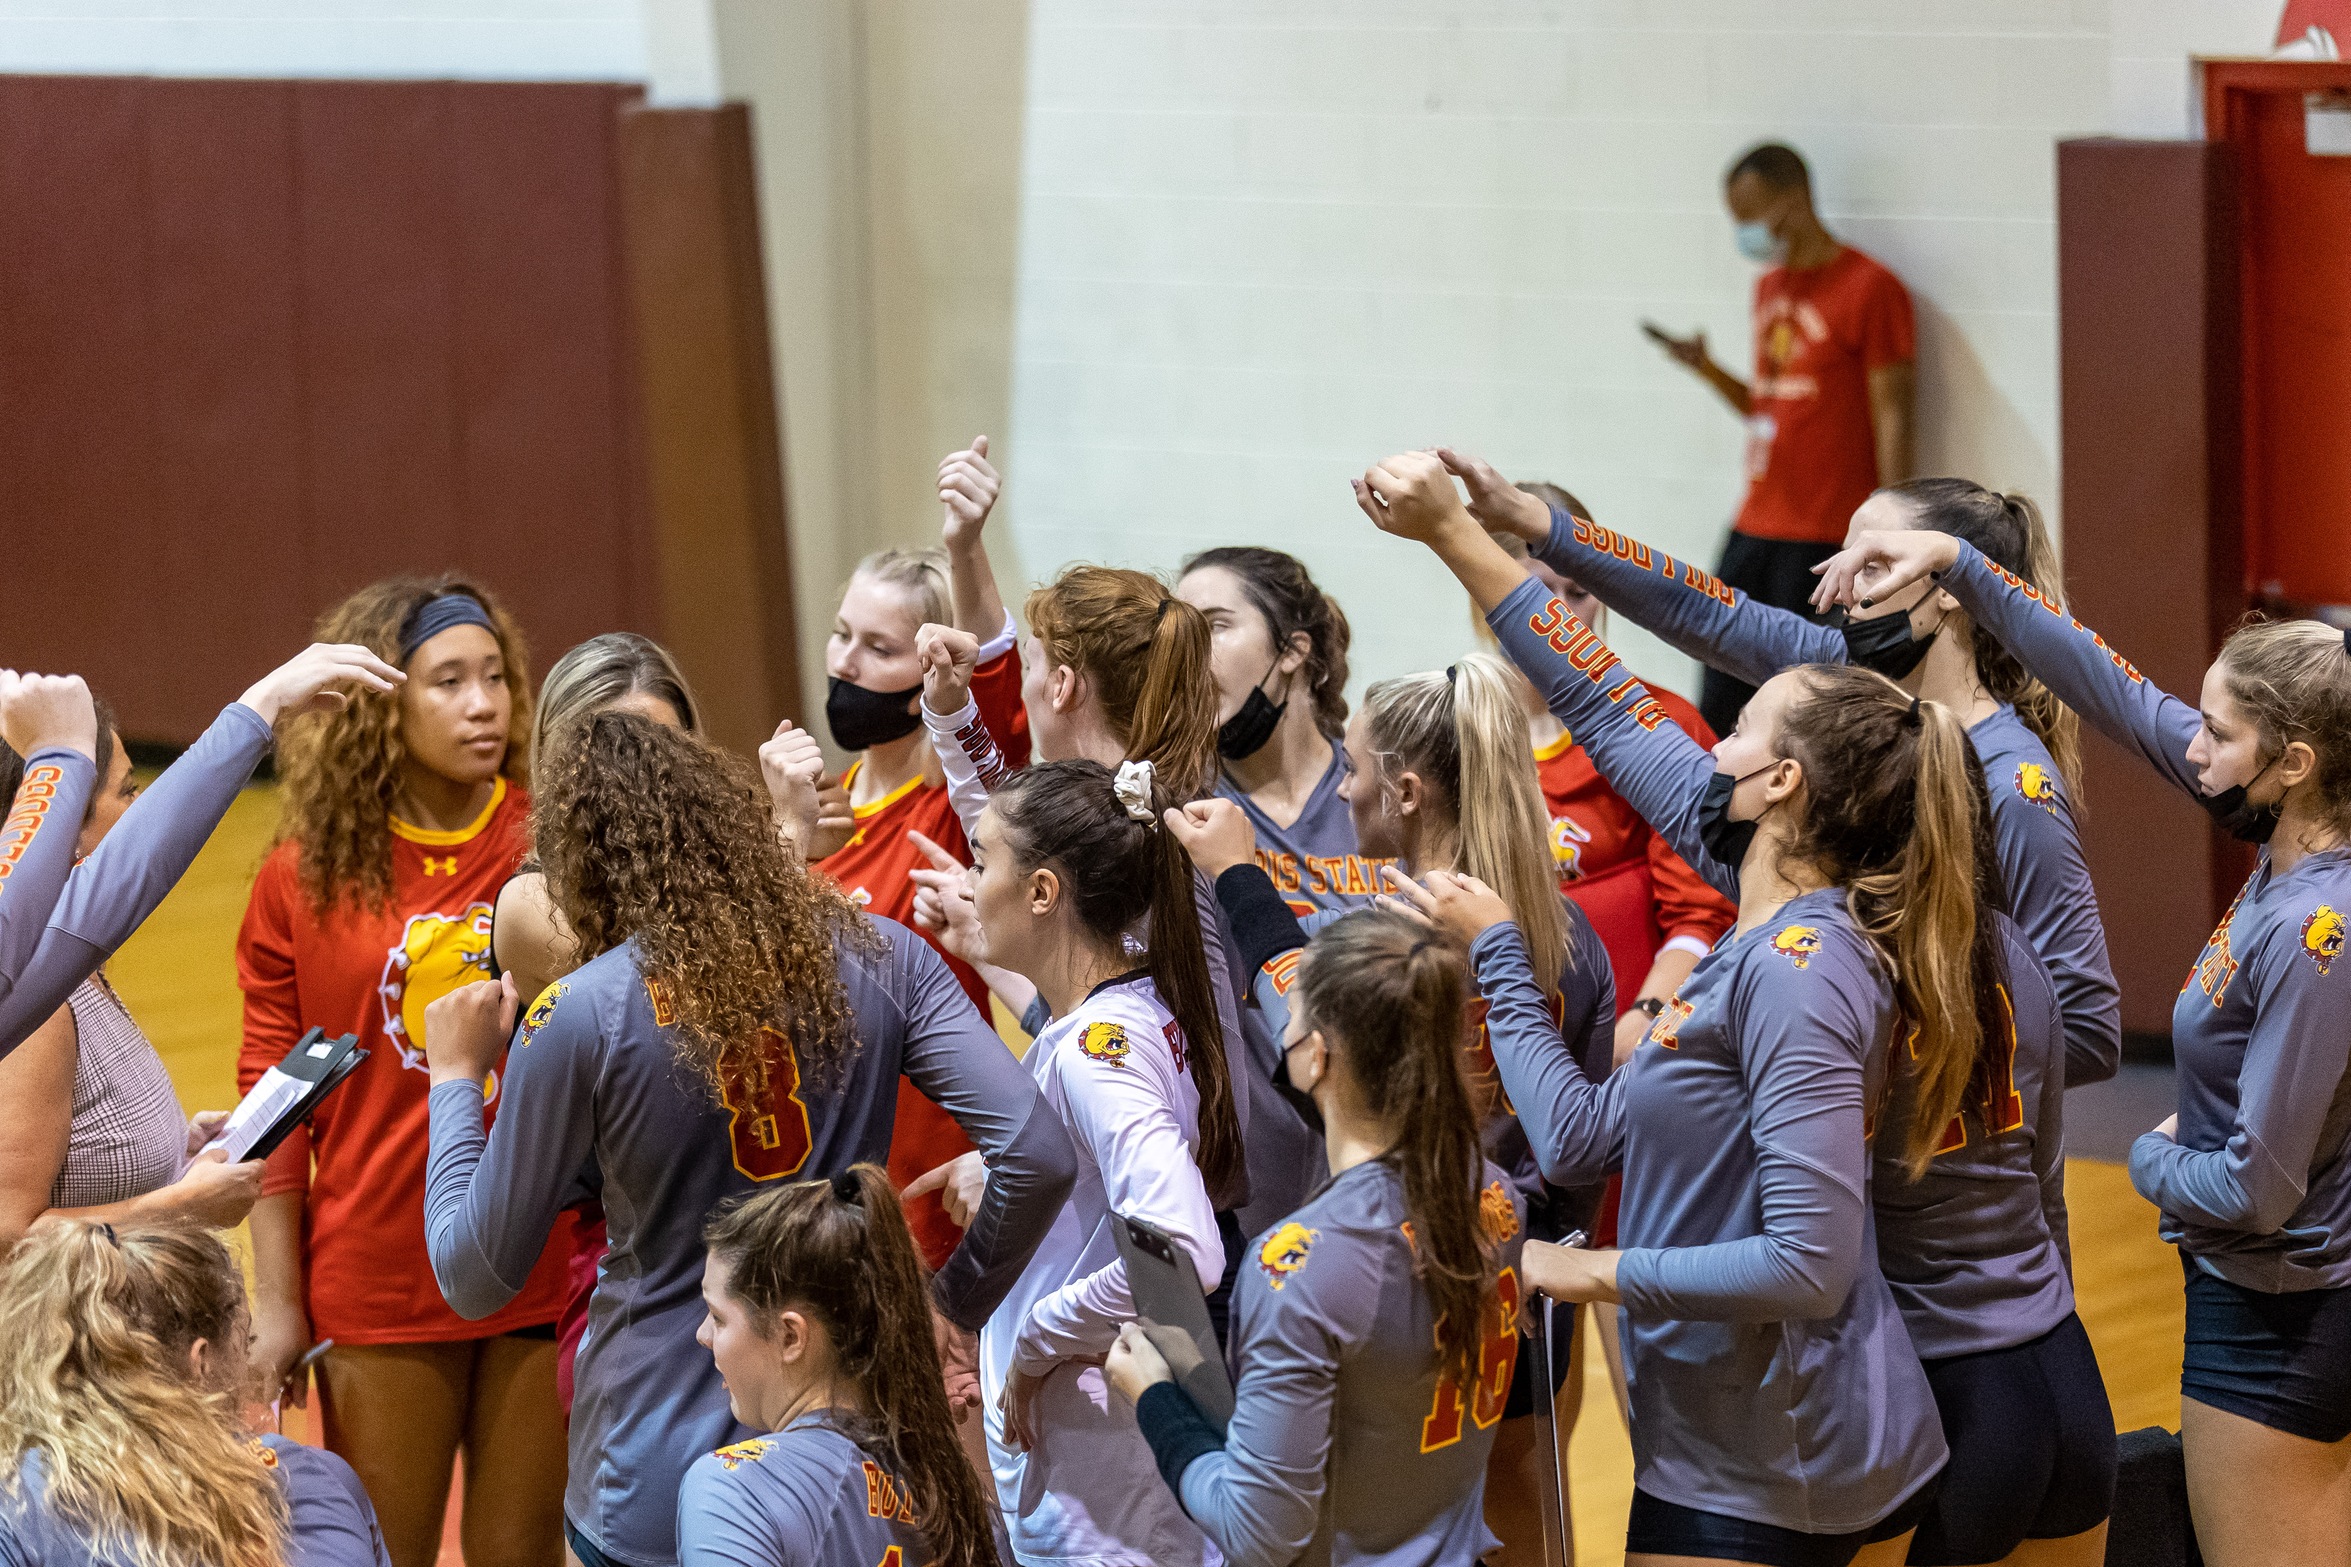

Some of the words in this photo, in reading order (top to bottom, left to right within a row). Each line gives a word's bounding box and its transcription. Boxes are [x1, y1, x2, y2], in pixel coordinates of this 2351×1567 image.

[1529, 597, 1671, 732] BLLDOGS
[1305, 854, 1400, 895] STATE
[717, 1026, 813, 1182] 8
